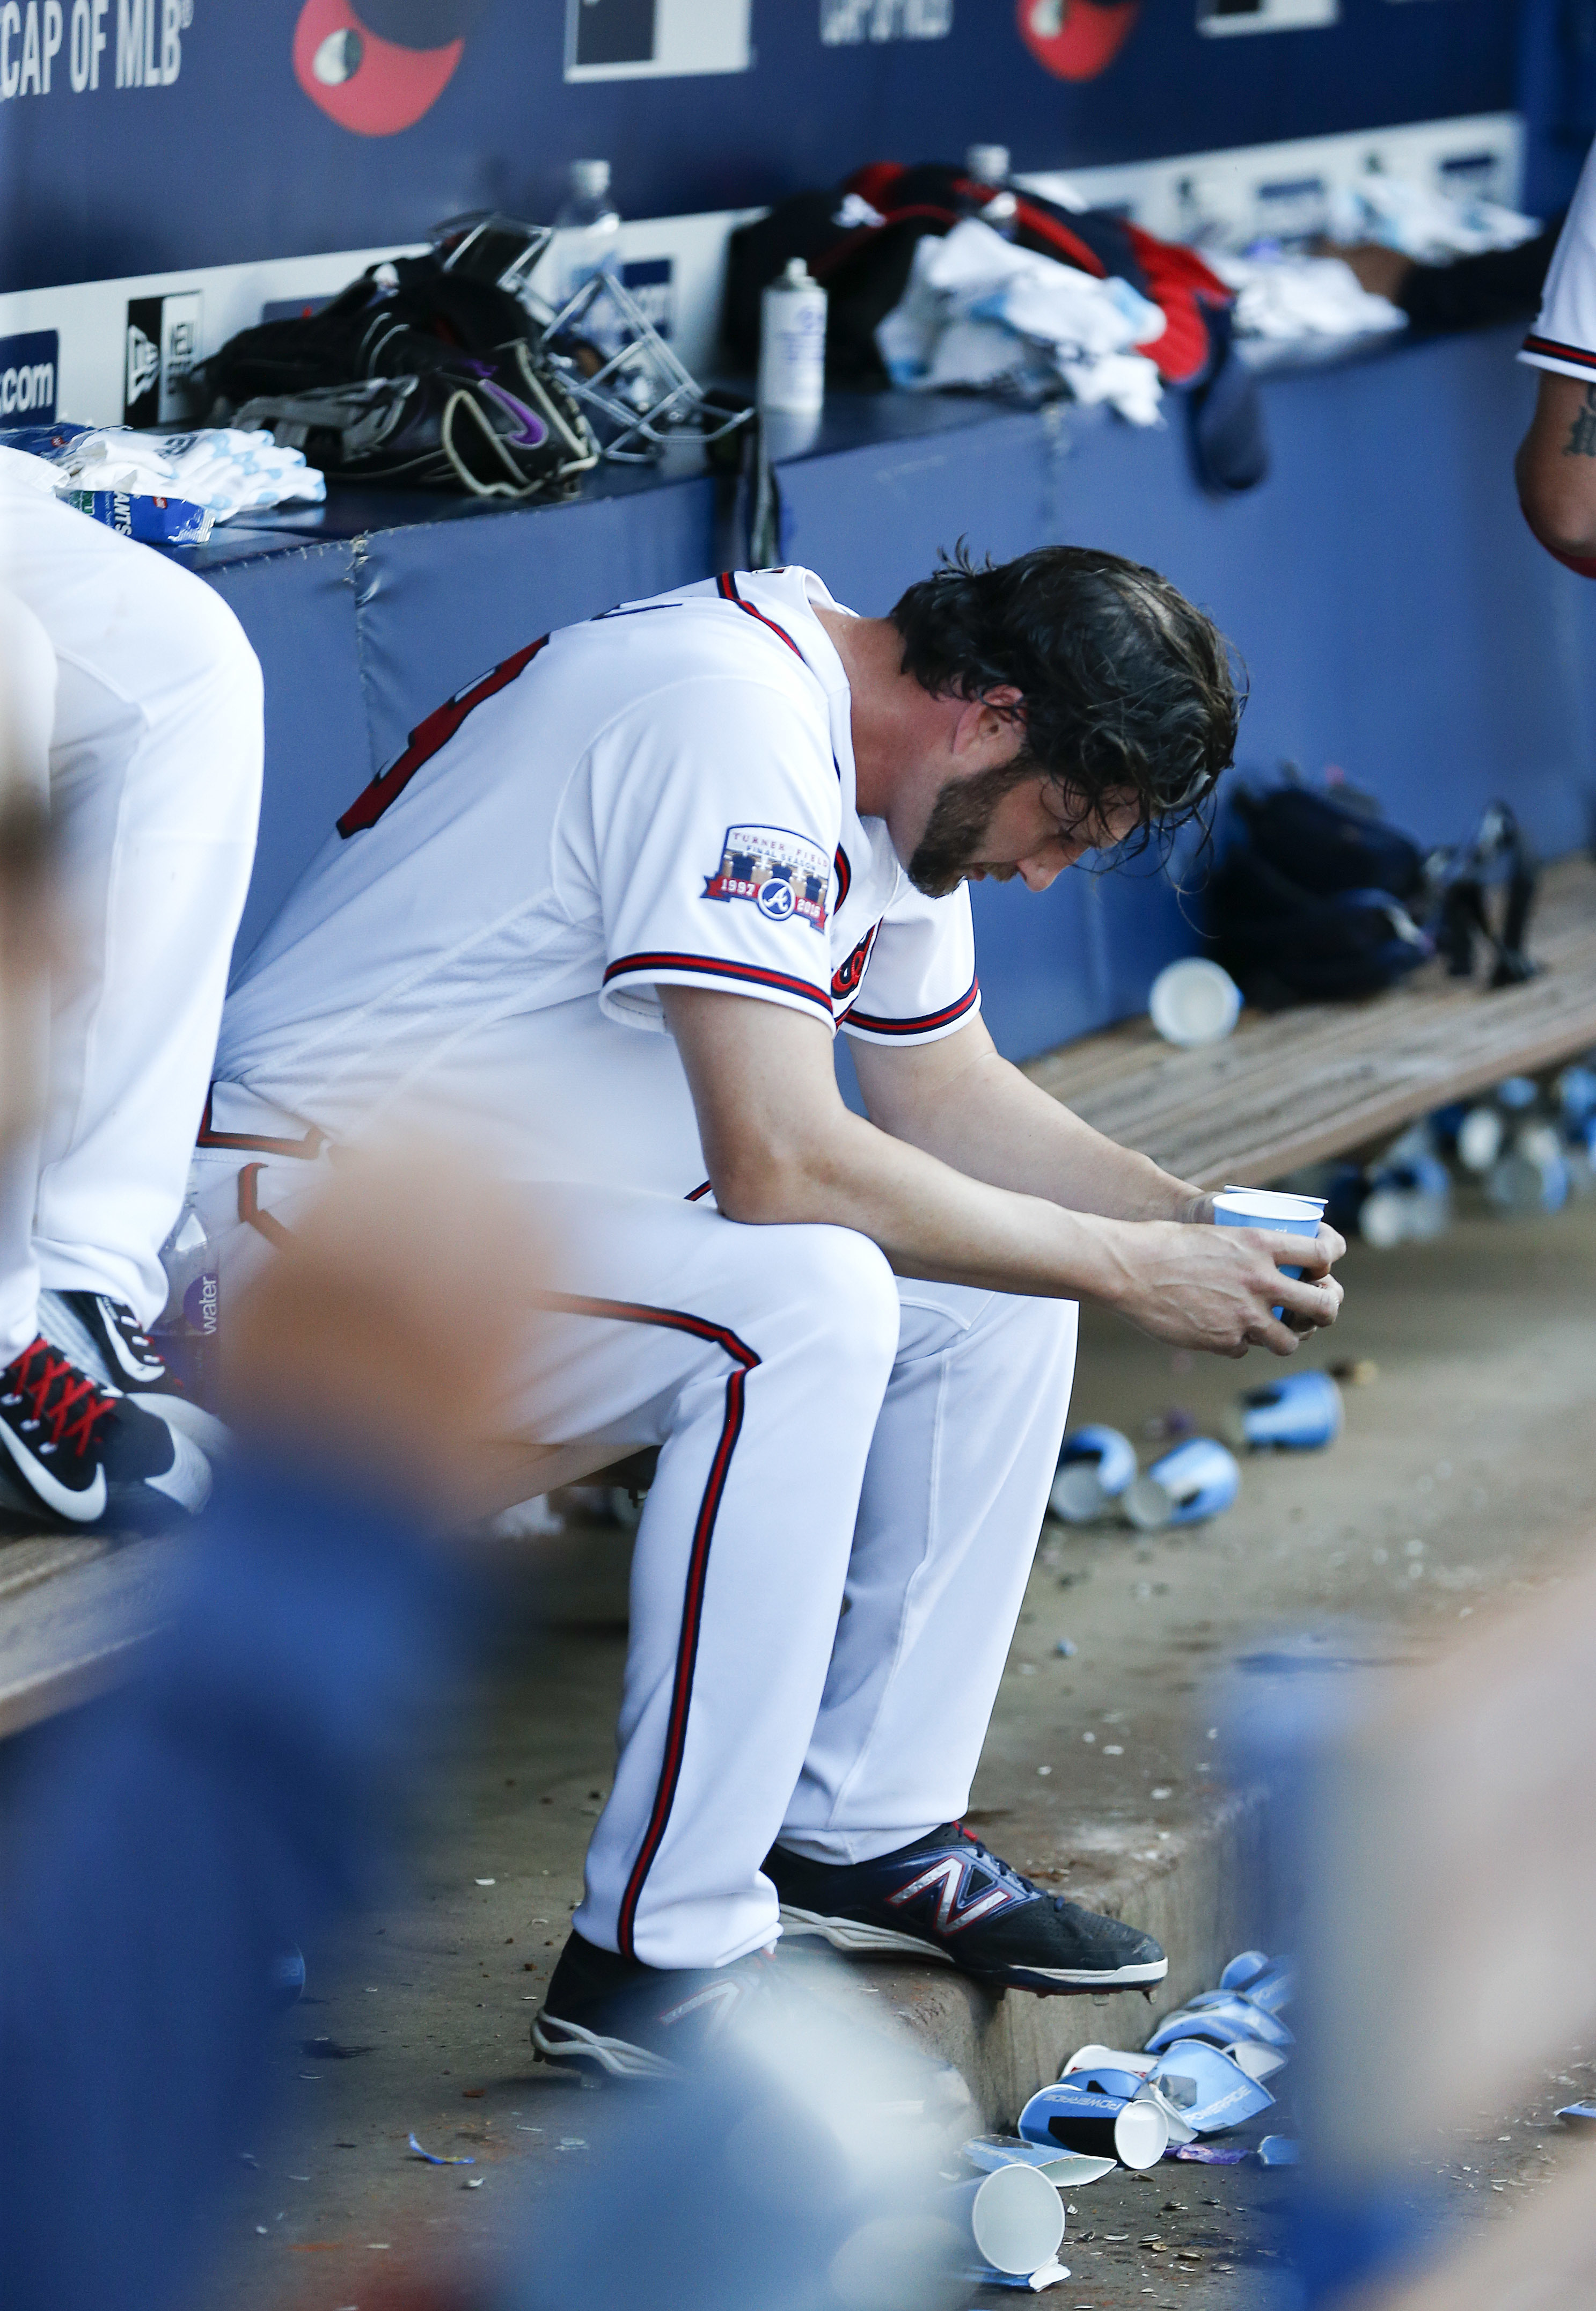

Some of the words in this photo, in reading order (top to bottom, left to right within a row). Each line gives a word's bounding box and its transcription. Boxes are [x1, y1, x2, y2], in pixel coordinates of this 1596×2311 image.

[1, 0, 63, 99] CAP
[70, 0, 109, 93] OF
[733, 832, 785, 851] TURNER
[796, 848, 828, 867] FIELD
[746, 845, 776, 858] FINAL
[780, 854, 816, 871] SEASON
[721, 878, 756, 896] 1997
[796, 898, 822, 919] 2016
[198, 1275, 217, 1335] water
[1043, 2094, 1123, 2111] POWERADE
